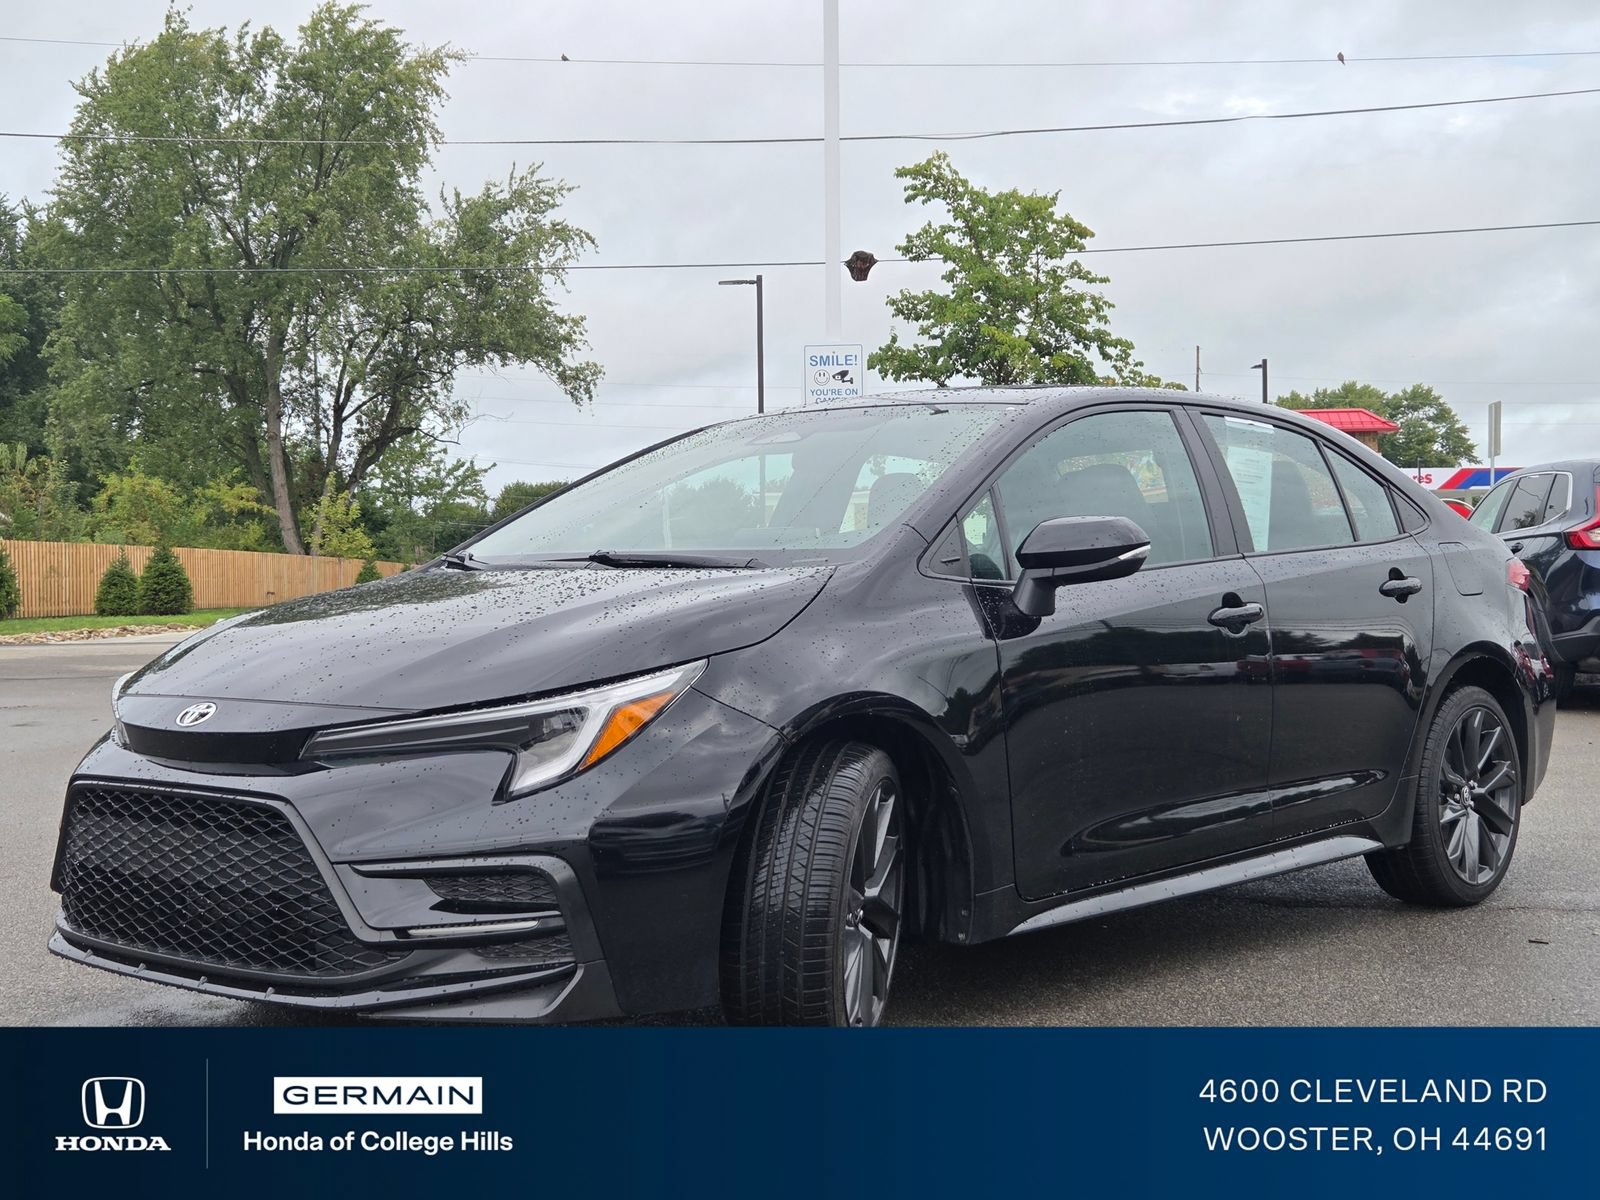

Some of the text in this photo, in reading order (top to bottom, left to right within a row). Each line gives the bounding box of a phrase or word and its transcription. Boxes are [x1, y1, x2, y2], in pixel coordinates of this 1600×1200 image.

[809, 354, 858, 367] SMILE!
[810, 388, 858, 396] YOU'RE ON
